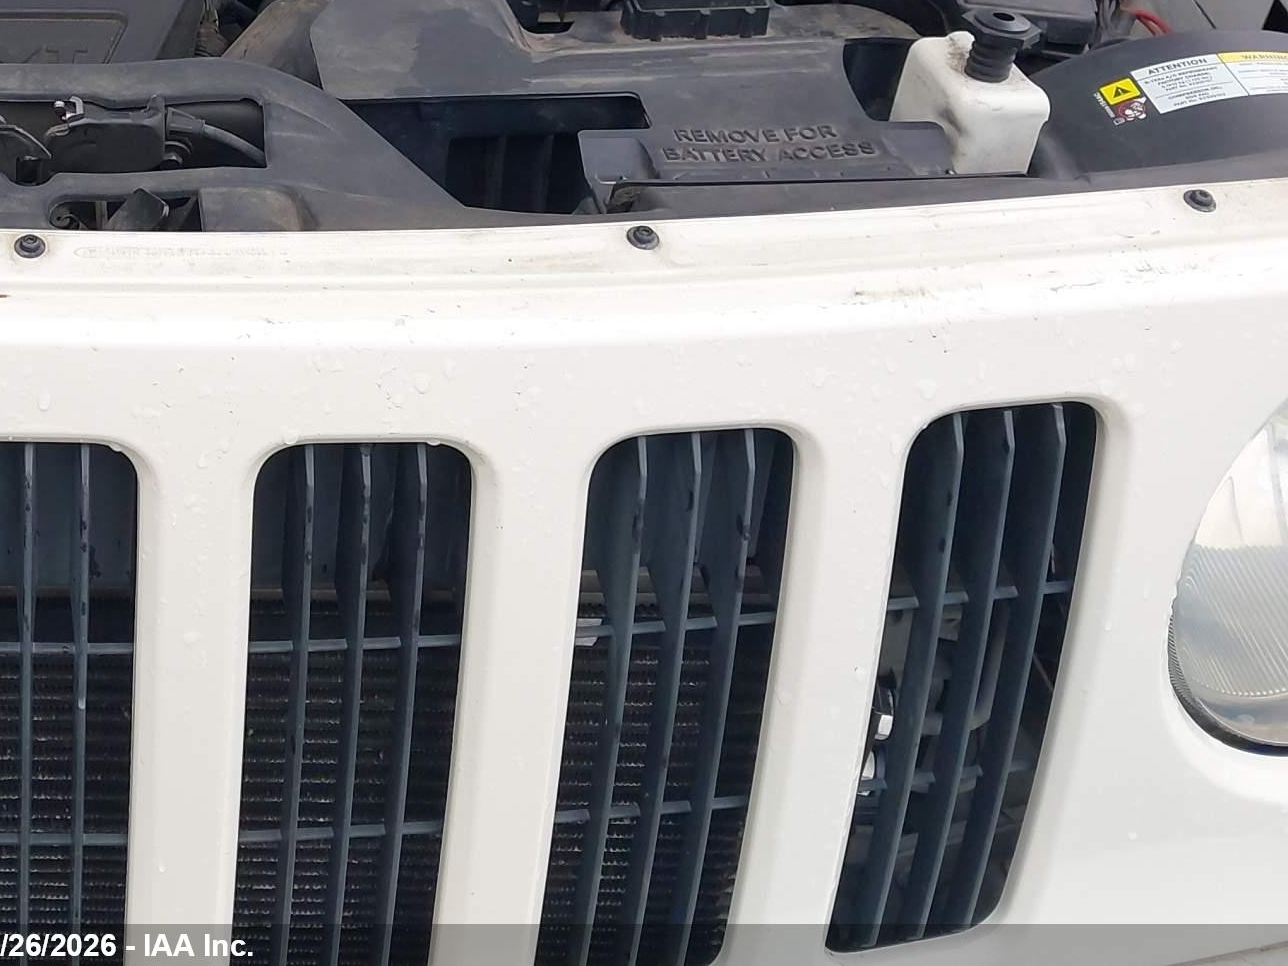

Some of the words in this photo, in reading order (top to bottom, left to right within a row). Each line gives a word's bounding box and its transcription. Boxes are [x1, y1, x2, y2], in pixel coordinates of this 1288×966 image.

[1147, 57, 1208, 75] ATTENTION
[673, 128, 779, 144] REMOVE
[783, 124, 838, 141] FOR
[662, 146, 767, 163] BATTERY
[778, 141, 877, 161] ACCESS
